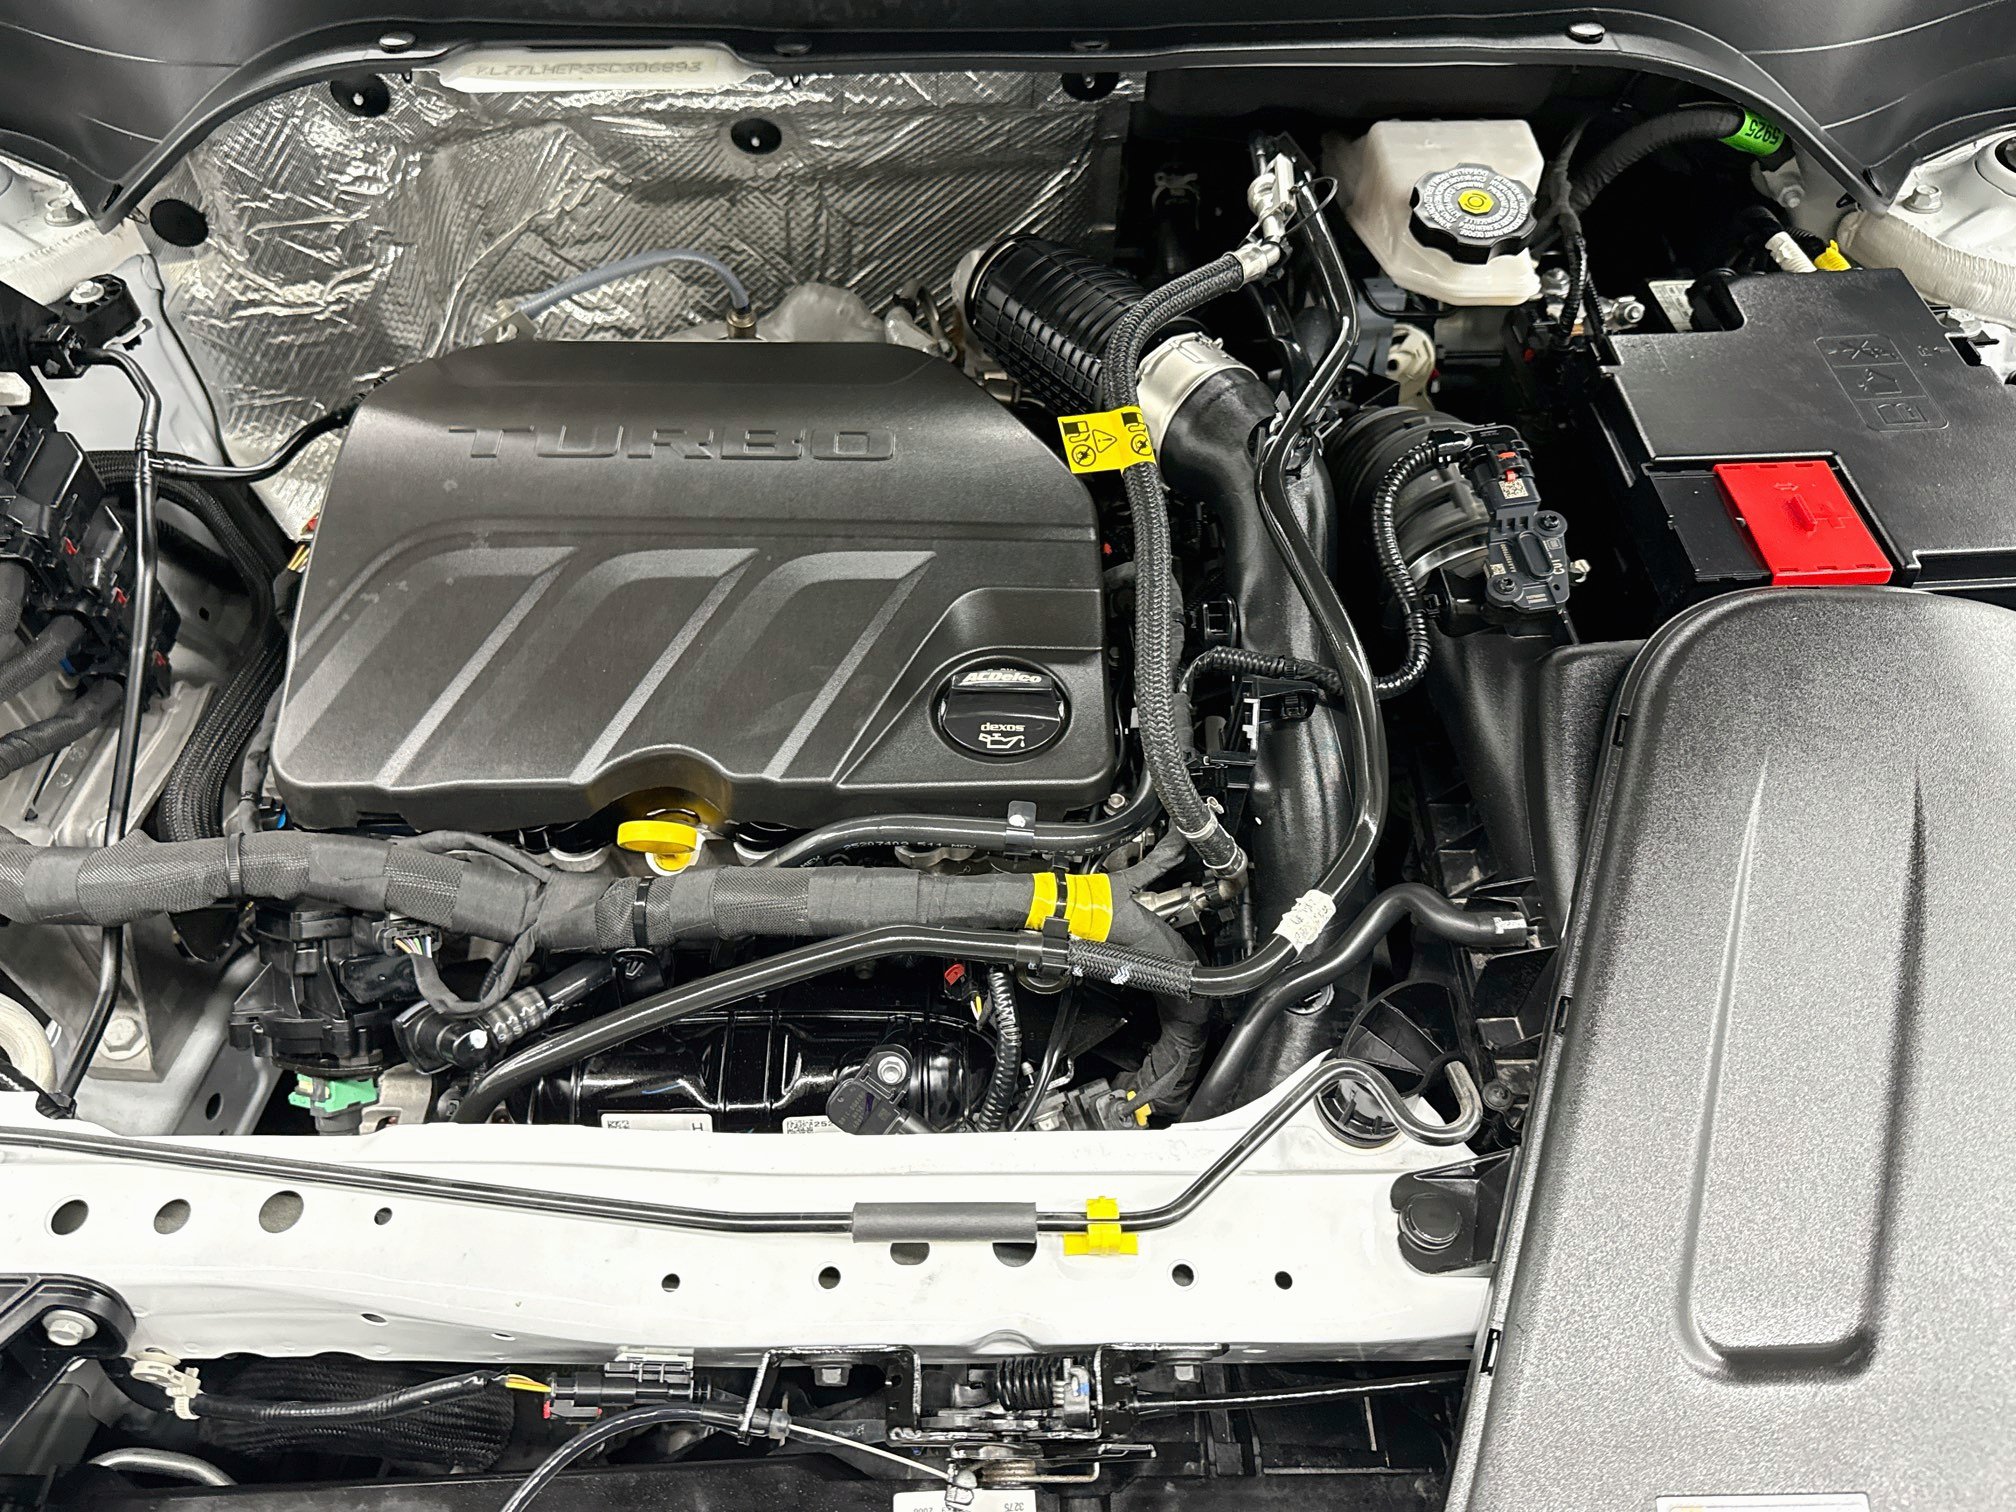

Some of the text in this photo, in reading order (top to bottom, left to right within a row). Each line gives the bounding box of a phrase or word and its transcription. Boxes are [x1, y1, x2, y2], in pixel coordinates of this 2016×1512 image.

[1745, 118, 1781, 146] 5925
[449, 424, 897, 461] TURBO
[960, 671, 1042, 685] ACDelco
[980, 722, 1025, 732] dexos
